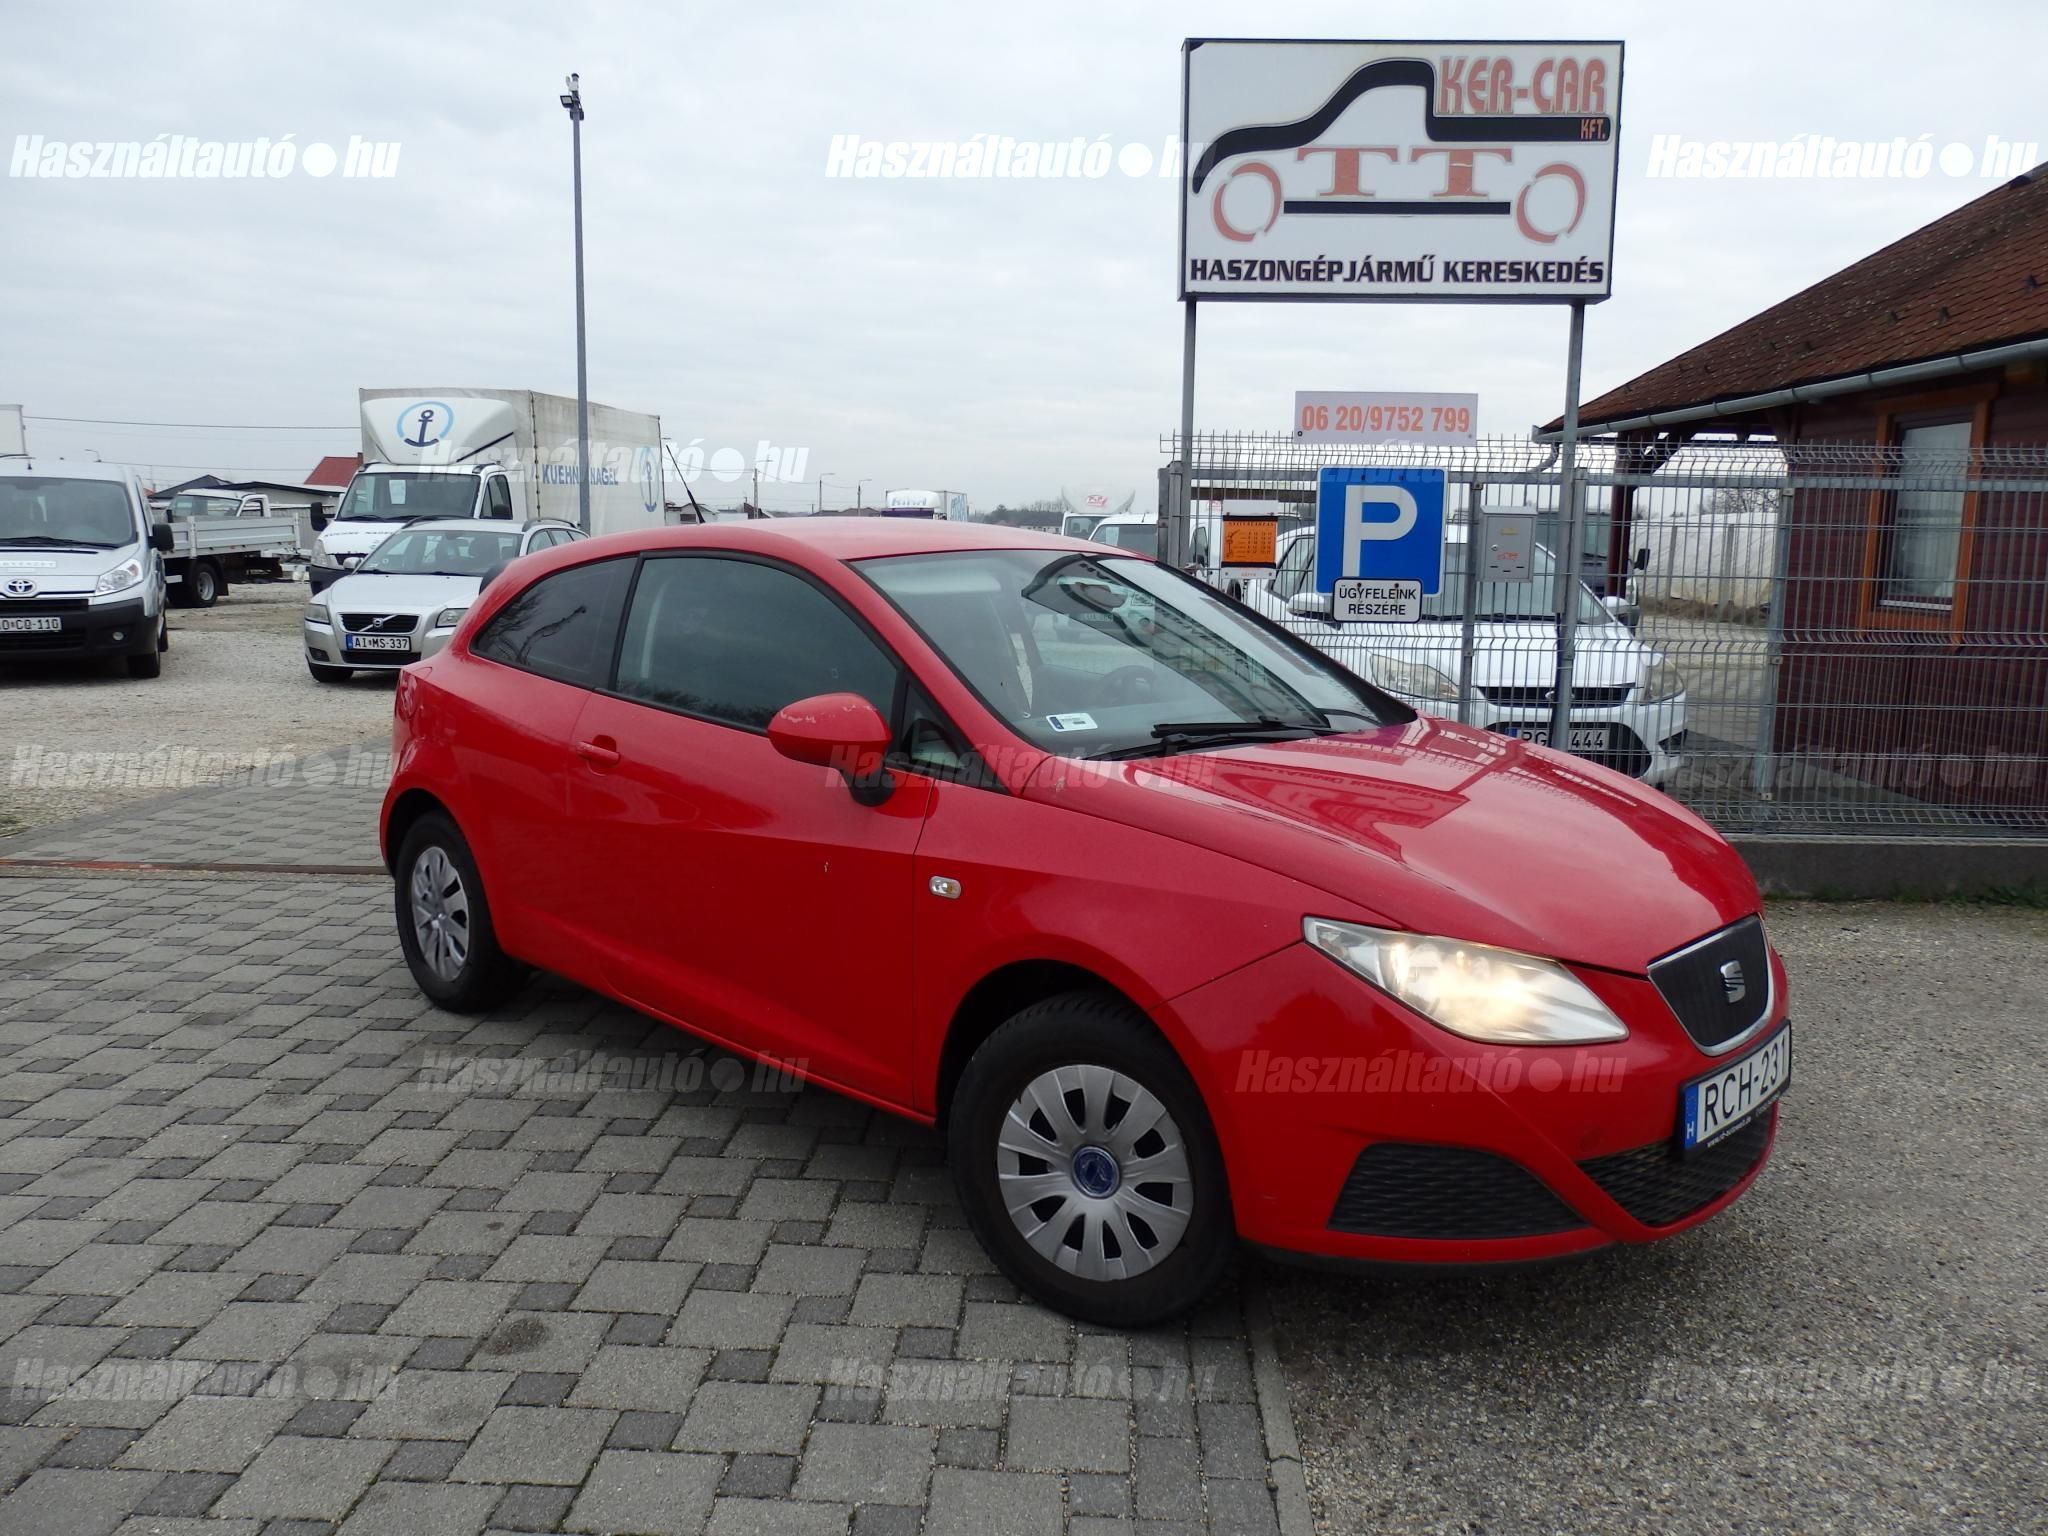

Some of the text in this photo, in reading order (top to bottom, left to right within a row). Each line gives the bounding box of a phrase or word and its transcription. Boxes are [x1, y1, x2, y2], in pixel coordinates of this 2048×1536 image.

[1437, 57, 1606, 114] KER-CAR
[1190, 256, 1604, 284] HASZONGÉPJÁRMŰ KERESKEDÉS
[1302, 405, 1470, 433] 06 20/9752 799
[542, 464, 582, 485] KUEHN
[1348, 601, 1406, 616] RÉSZÉRE
[1704, 1035, 1786, 1132] RCH-231
